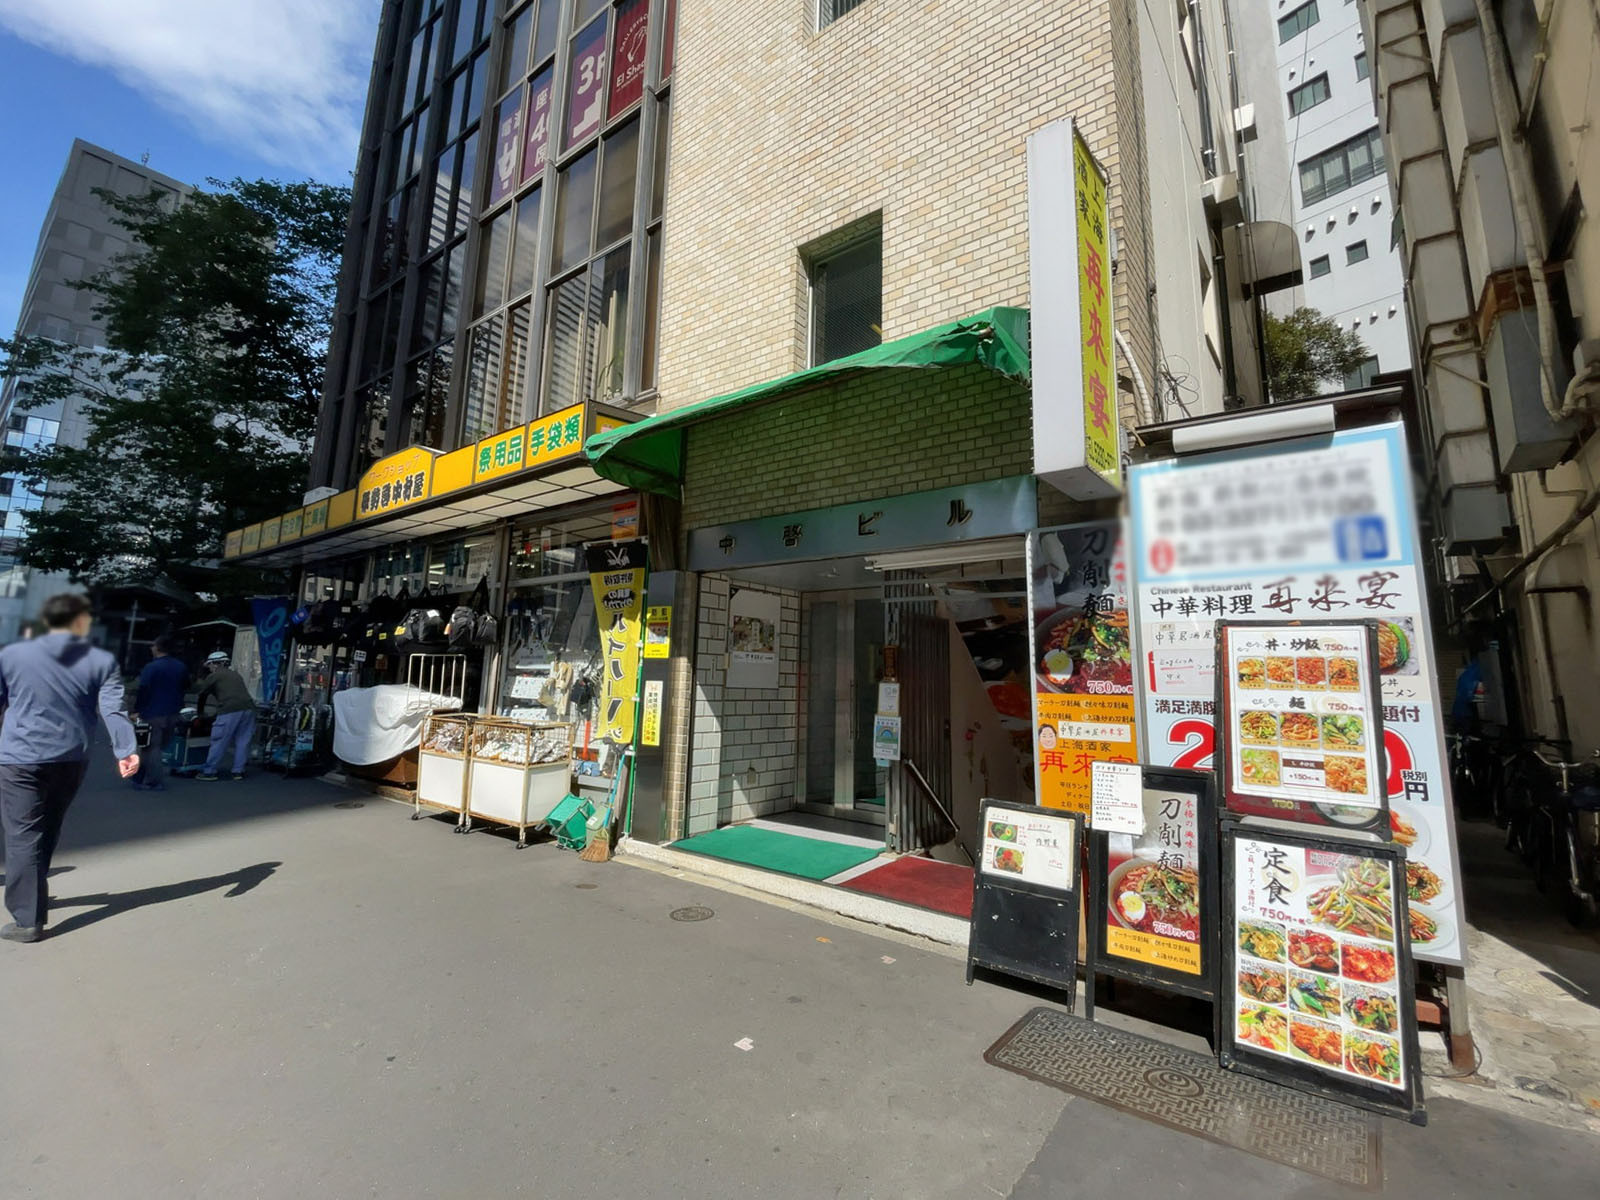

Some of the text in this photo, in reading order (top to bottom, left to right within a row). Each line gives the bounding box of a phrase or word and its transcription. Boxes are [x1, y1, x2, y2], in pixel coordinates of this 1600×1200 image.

[530, 413, 582, 457] 手袋類
[478, 434, 523, 474] 祭用品
[1150, 582, 1252, 596] Chinese Restaurant
[1261, 571, 1403, 614] 再来宴
[1151, 594, 1257, 619] 中華料理
[1265, 638, 1321, 652] 丼・炒飯
[1288, 696, 1307, 710] 麺
[1060, 739, 1112, 752] 上海酒家
[1402, 770, 1428, 782] 税別
[1405, 781, 1430, 802] 円
[1157, 798, 1185, 876] 刀削麺
[1261, 846, 1292, 907] 定食
